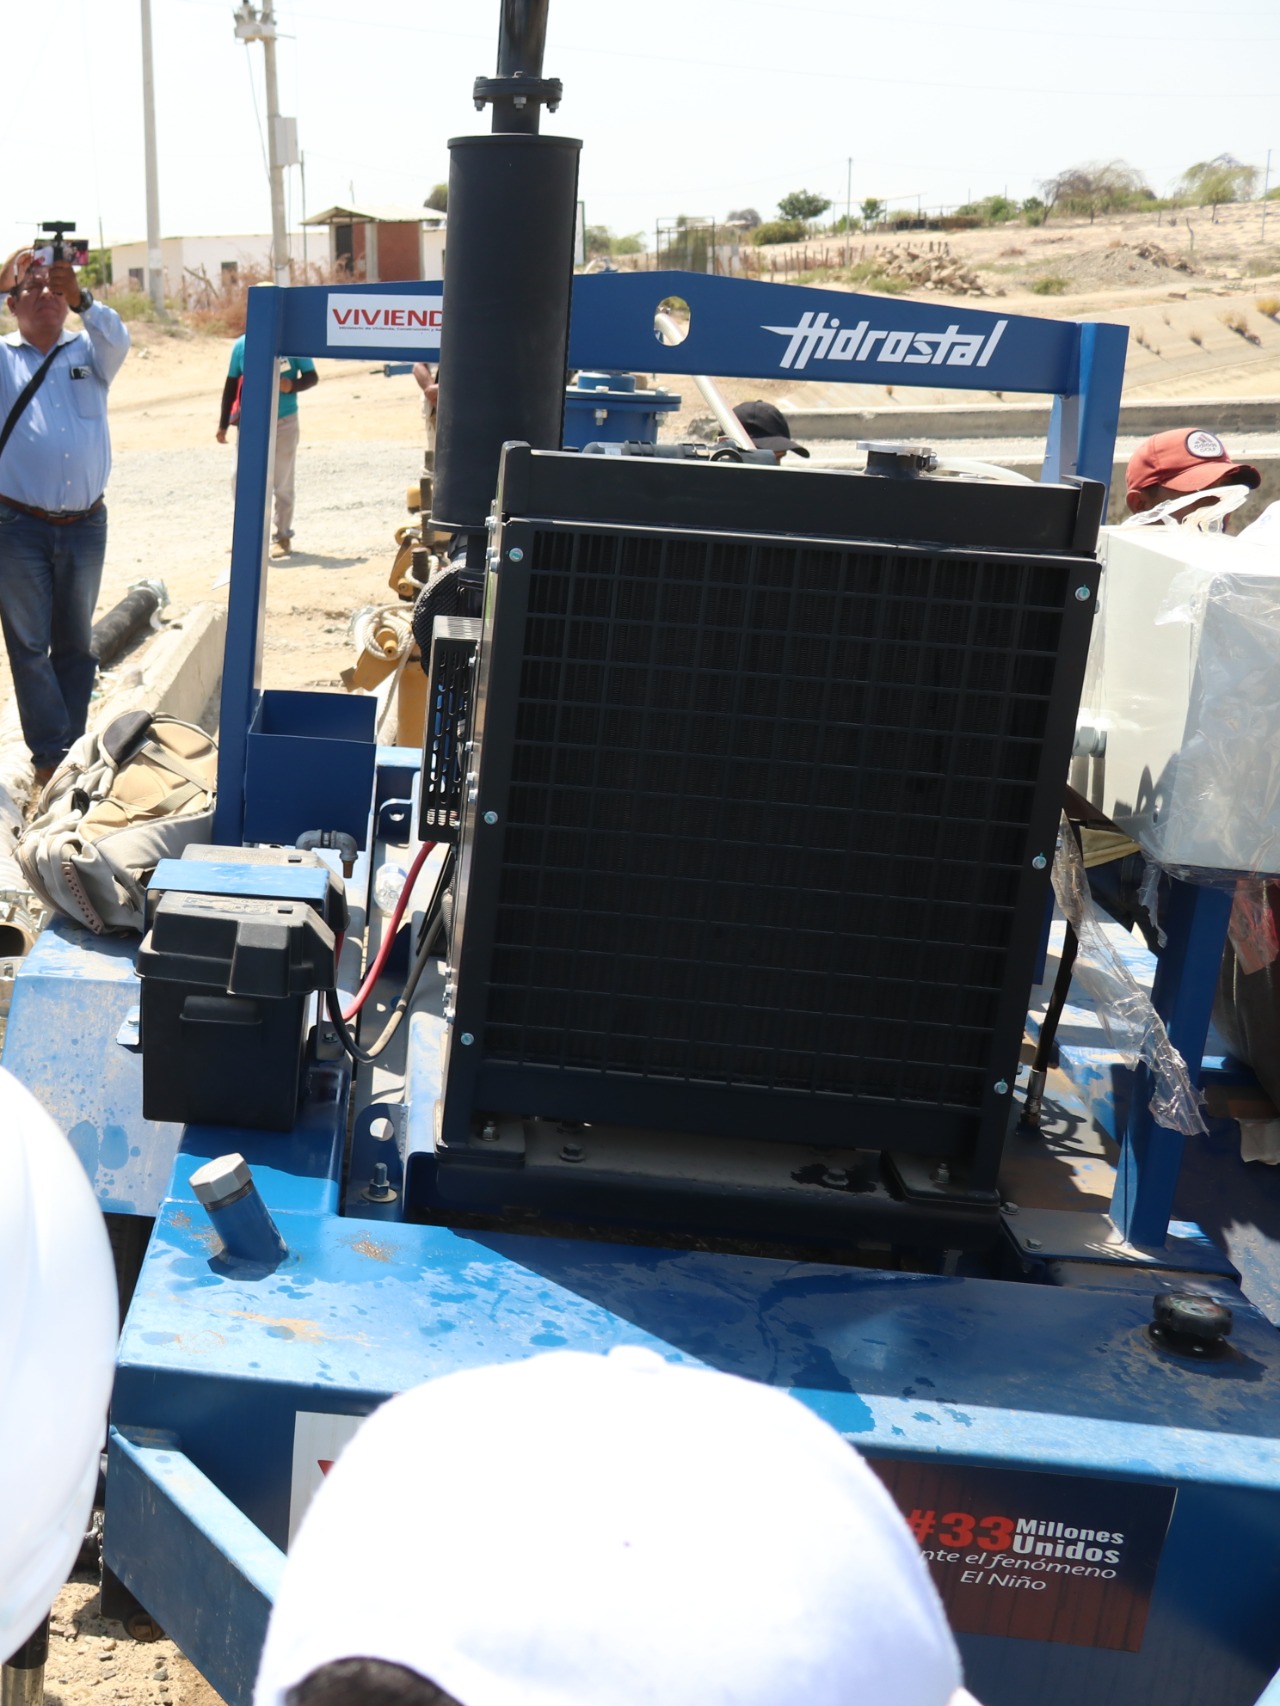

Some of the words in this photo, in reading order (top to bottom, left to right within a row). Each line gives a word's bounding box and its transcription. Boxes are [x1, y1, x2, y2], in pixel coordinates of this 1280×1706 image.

[760, 311, 1009, 369] Hidrostal
[906, 1509, 1015, 1551] #33
[1016, 1518, 1124, 1545] Millones
[1012, 1534, 1121, 1564] Unidos
[965, 1552, 987, 1565] el
[984, 1554, 1117, 1579] fenómeno
[960, 1570, 984, 1584] El
[987, 1573, 1047, 1591] Niño
